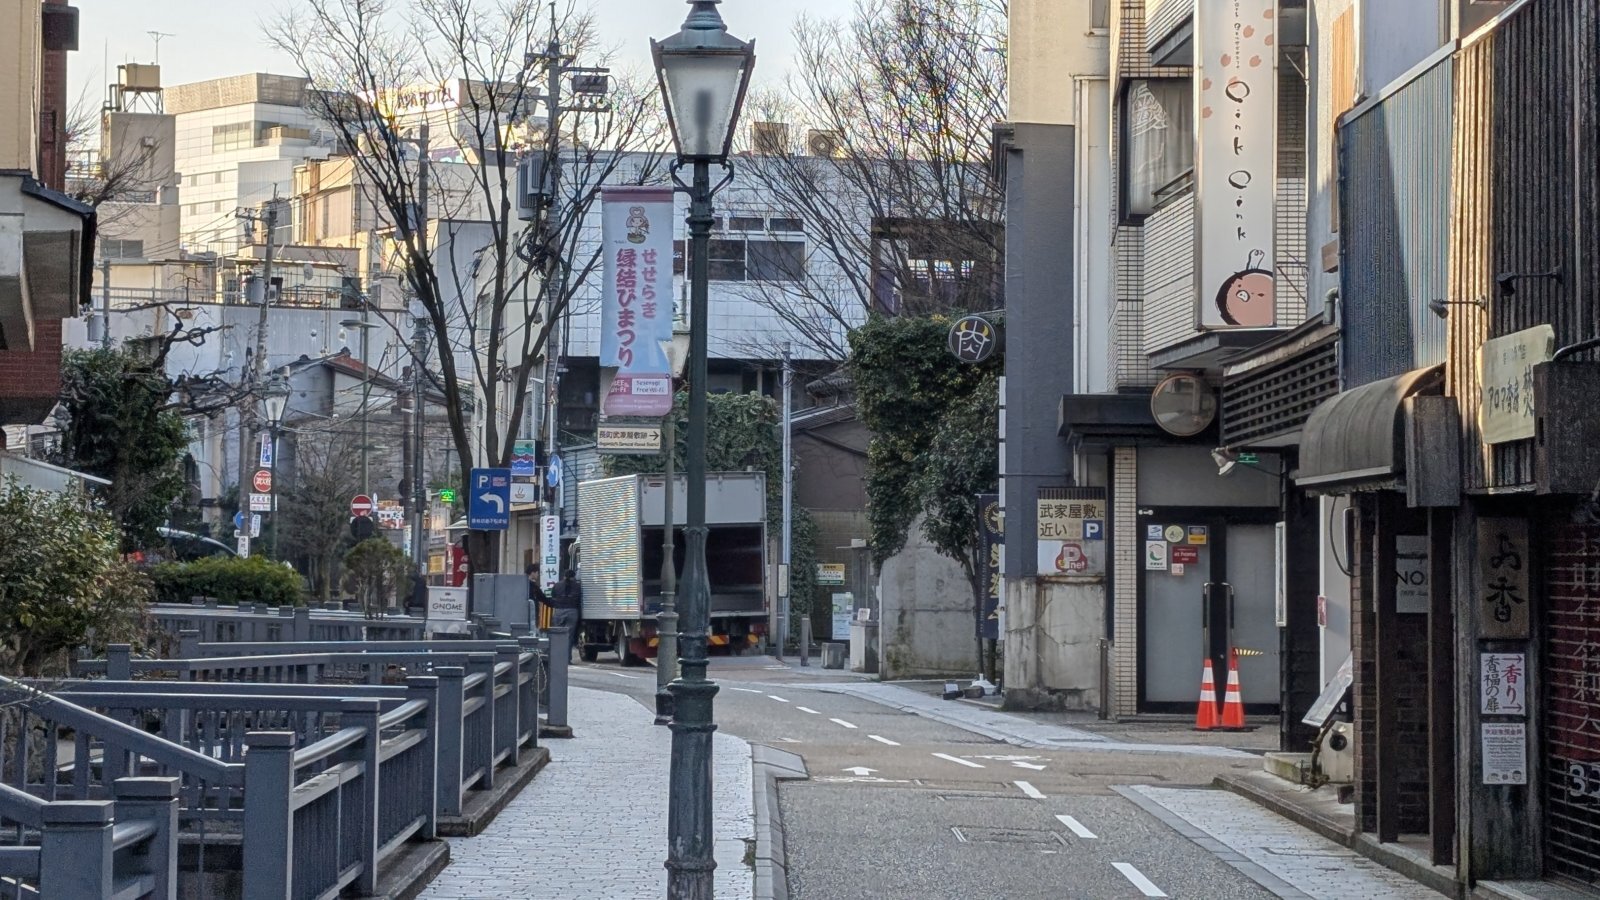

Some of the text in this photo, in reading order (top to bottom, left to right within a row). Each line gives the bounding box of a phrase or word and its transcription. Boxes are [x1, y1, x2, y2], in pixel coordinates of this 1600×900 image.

[1225, 81, 1250, 155] Oink
[1228, 170, 1251, 240] Oink
[641, 248, 658, 319] せせらぎ
[616, 248, 637, 368] 縁結びまつり
[479, 475, 489, 489] P
[1039, 503, 1104, 519] 武家屋敷に
[1040, 522, 1067, 537] 近い
[1086, 522, 1099, 538] P
[432, 602, 463, 611] GNOME
[1501, 664, 1522, 705] 香り
